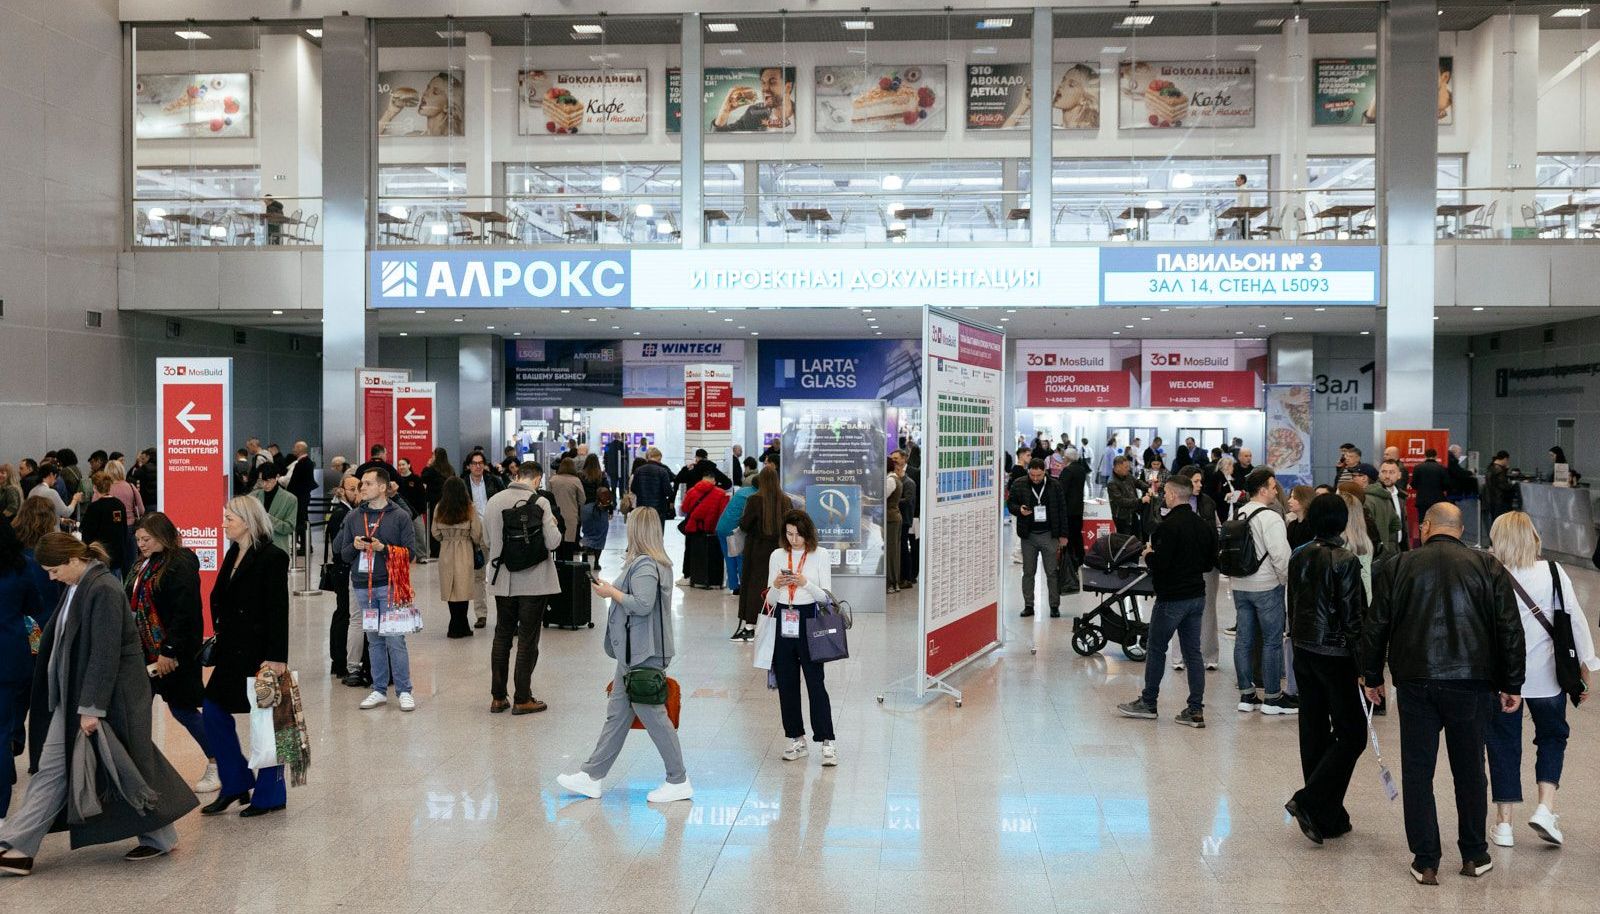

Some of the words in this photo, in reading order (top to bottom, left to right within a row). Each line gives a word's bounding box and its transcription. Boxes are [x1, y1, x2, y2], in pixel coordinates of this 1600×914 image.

[970, 66, 992, 75] ЭТО
[557, 74, 643, 84] ШОКОЛАДНИЦА
[970, 76, 1026, 86] АВОКАДО,
[970, 86, 1008, 97] ДЕТКА!
[1190, 90, 1233, 110] Кофе
[586, 97, 626, 121] Кофе
[1156, 252, 1276, 272] ПАВИЛЬОН
[1309, 252, 1323, 272] 3
[424, 259, 625, 298] АЛРОКС
[689, 268, 708, 290] И
[711, 268, 844, 290] ПРОЕКТНАЯ
[849, 268, 1041, 292] ДОКУМЕНТАЦИЯ
[1148, 278, 1184, 293] ЗАЛ
[1190, 278, 1213, 295] 14,
[1219, 278, 1277, 295] СТЕНД
[1282, 278, 1330, 293] L5093
[661, 343, 722, 353] WINTECH
[1059, 357, 1104, 367] MosBuild
[1183, 357, 1229, 367] MosBuild
[188, 368, 223, 376] MosBuild
[801, 374, 857, 389] GLASS
[1045, 375, 1076, 385] ДОБРО
[1169, 381, 1214, 389] WELCOME!
[1315, 374, 1359, 395] Зал
[1045, 385, 1110, 393] ПОЖАЛОВАТЬ!
[1326, 396, 1358, 411] Hall
[168, 438, 219, 447] РЕГИСТРАЦИЯ
